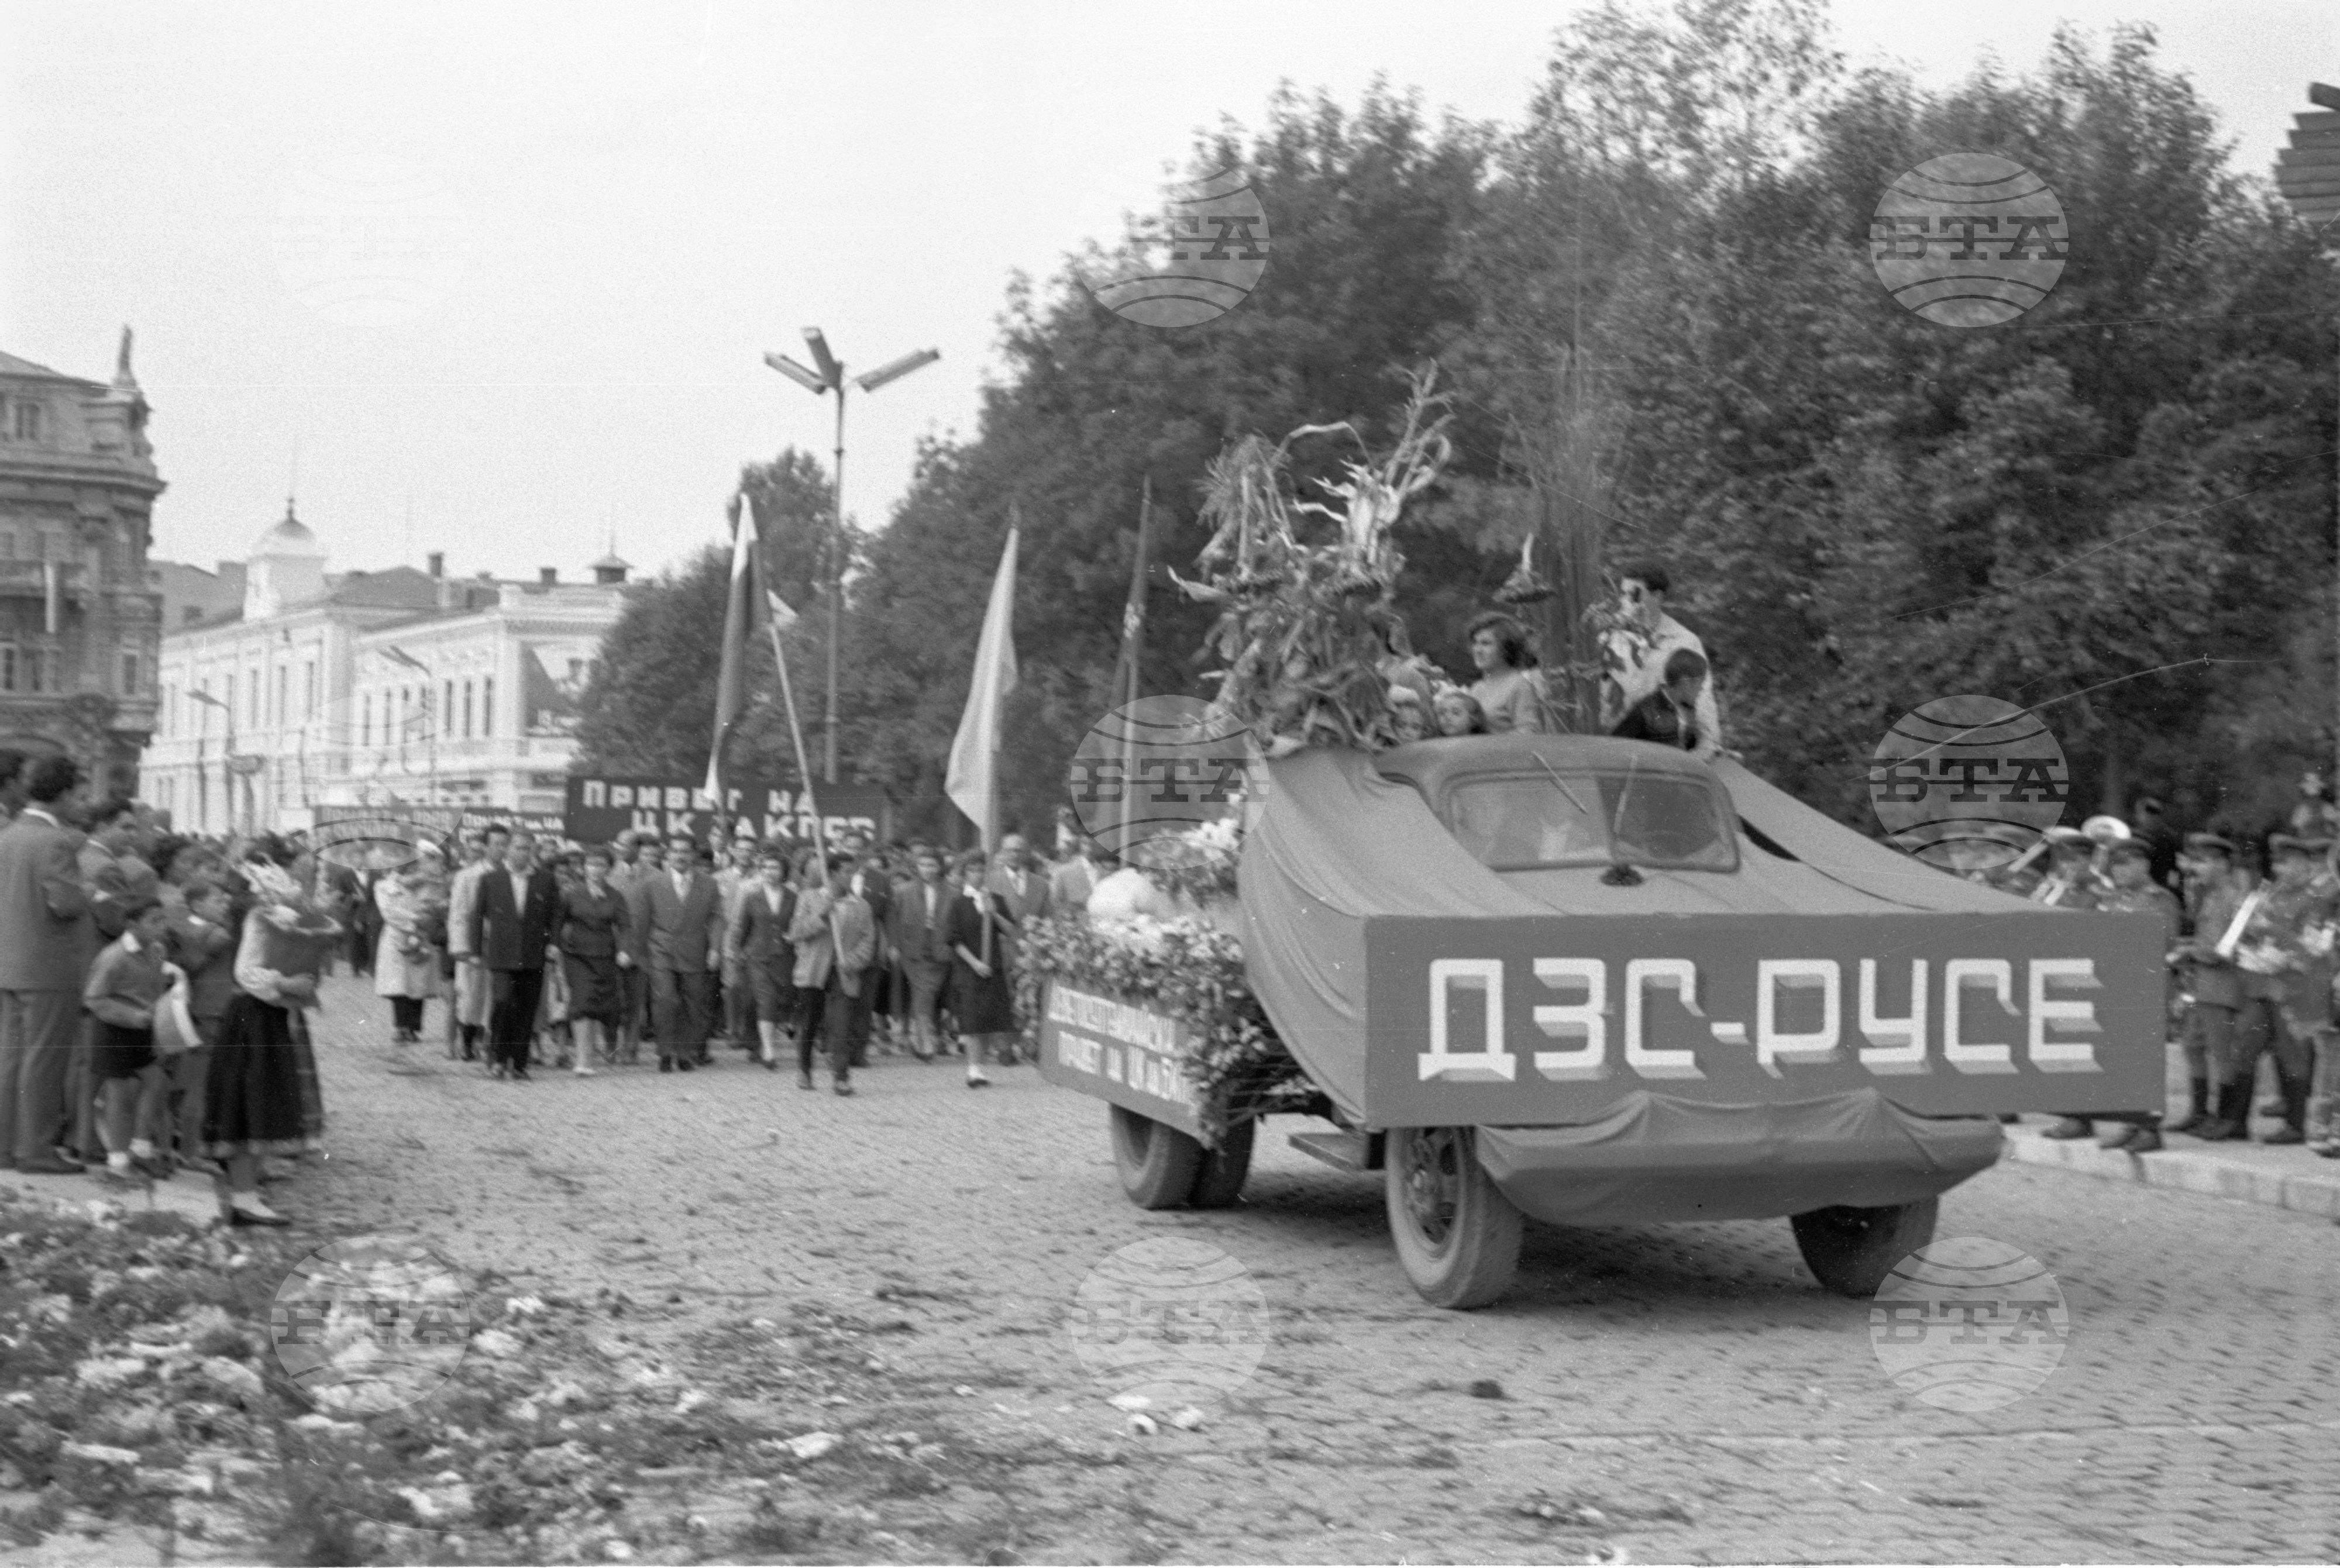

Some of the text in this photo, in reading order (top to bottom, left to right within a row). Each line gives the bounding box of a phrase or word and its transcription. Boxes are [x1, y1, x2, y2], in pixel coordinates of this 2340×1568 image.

[768, 790, 817, 814] НА
[631, 809, 696, 838] ЦК
[1418, 958, 2104, 1081] ДЗС-РУСЕ
